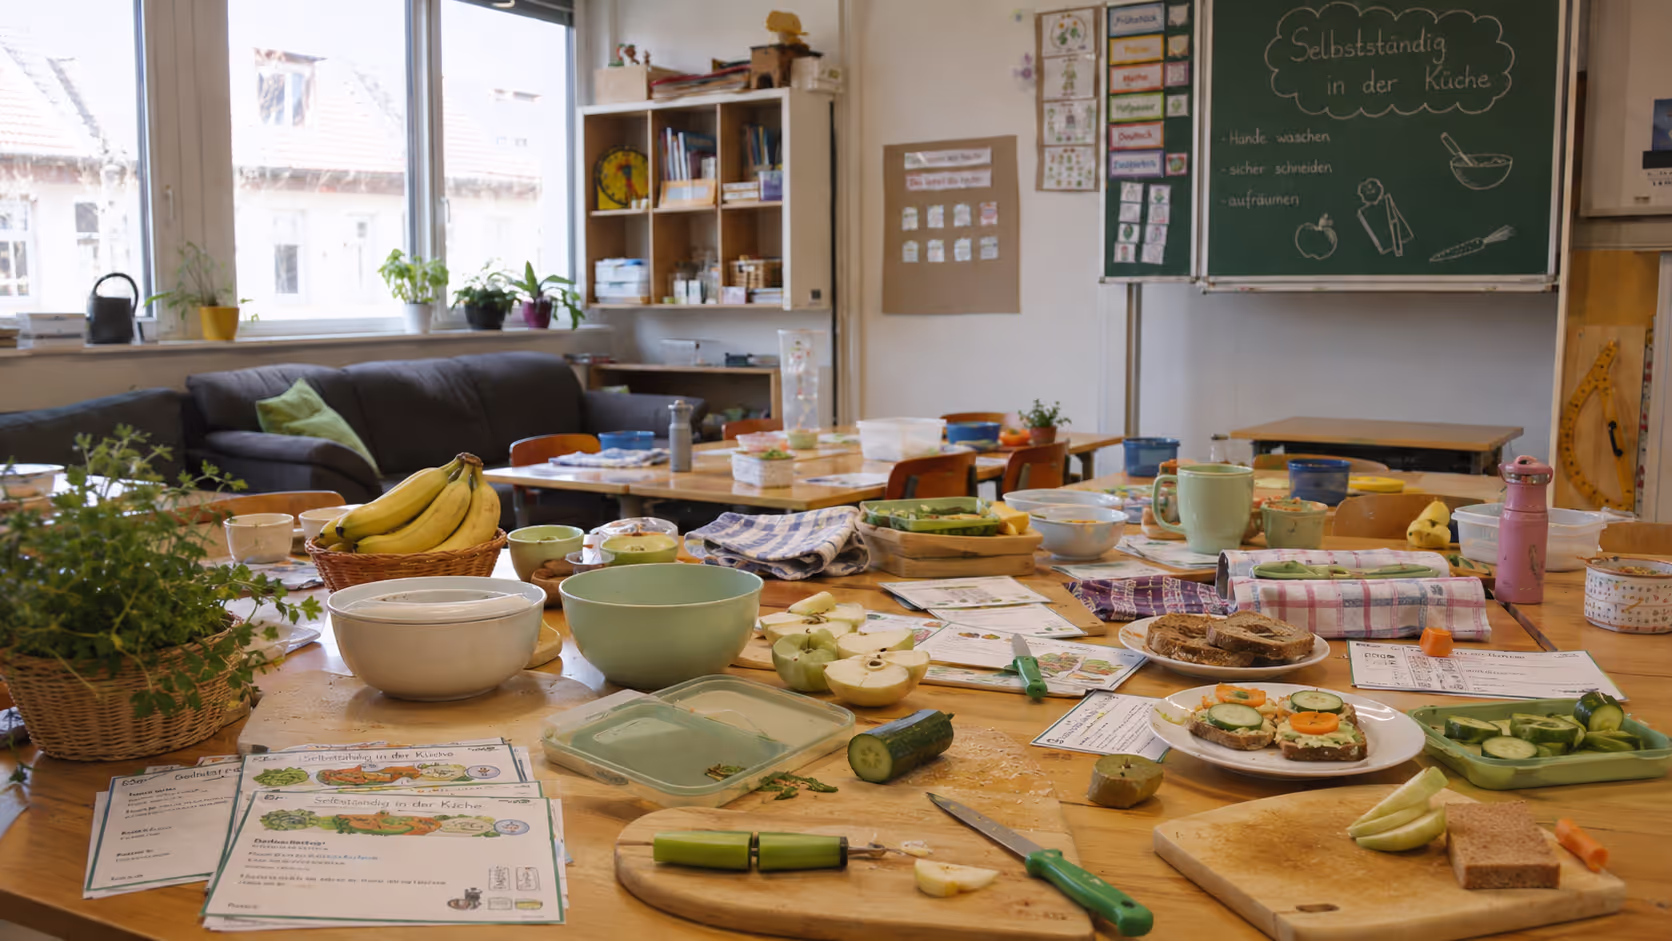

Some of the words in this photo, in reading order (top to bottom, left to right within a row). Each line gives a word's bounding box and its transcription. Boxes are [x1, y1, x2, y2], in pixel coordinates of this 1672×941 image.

[1290, 26, 1447, 64] Selbstständig
[1327, 74, 1345, 96] in
[1362, 67, 1399, 94] der
[1425, 63, 1492, 91] Küche
[1275, 127, 1331, 143] waschen
[1229, 160, 1264, 175] sicher
[1275, 158, 1333, 175] schneiden
